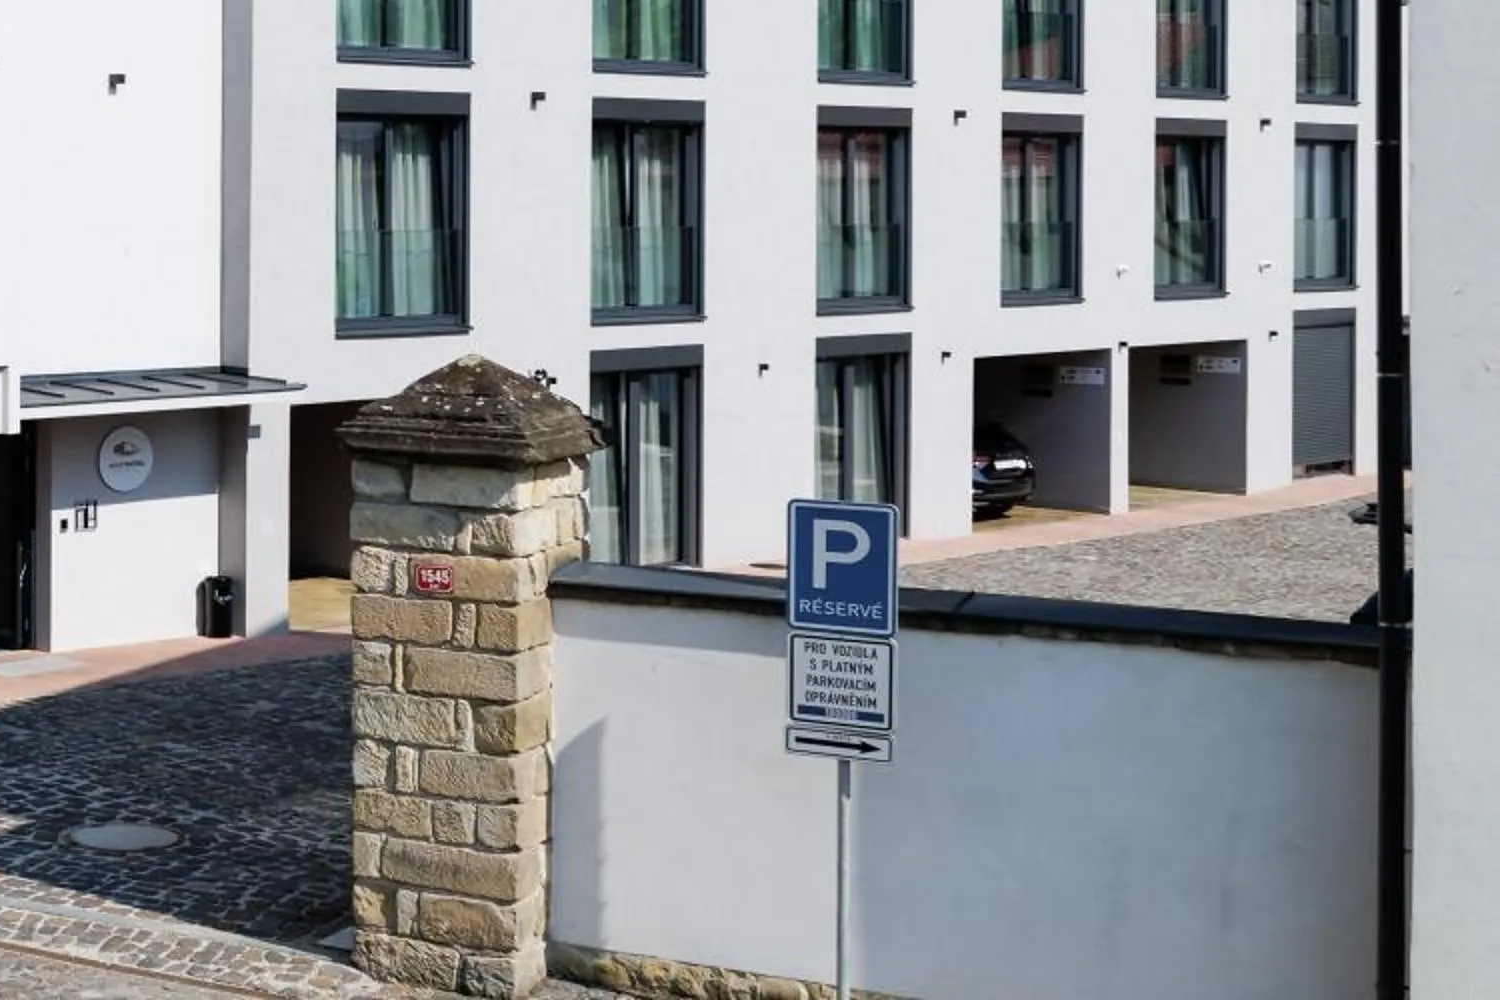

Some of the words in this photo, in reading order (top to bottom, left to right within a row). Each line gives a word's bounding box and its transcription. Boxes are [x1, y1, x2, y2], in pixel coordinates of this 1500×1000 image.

[812, 518, 871, 590] P
[420, 569, 449, 584] 1545
[804, 642, 827, 655] PRO
[832, 644, 878, 660] VOZIDLA
[809, 658, 817, 670] S
